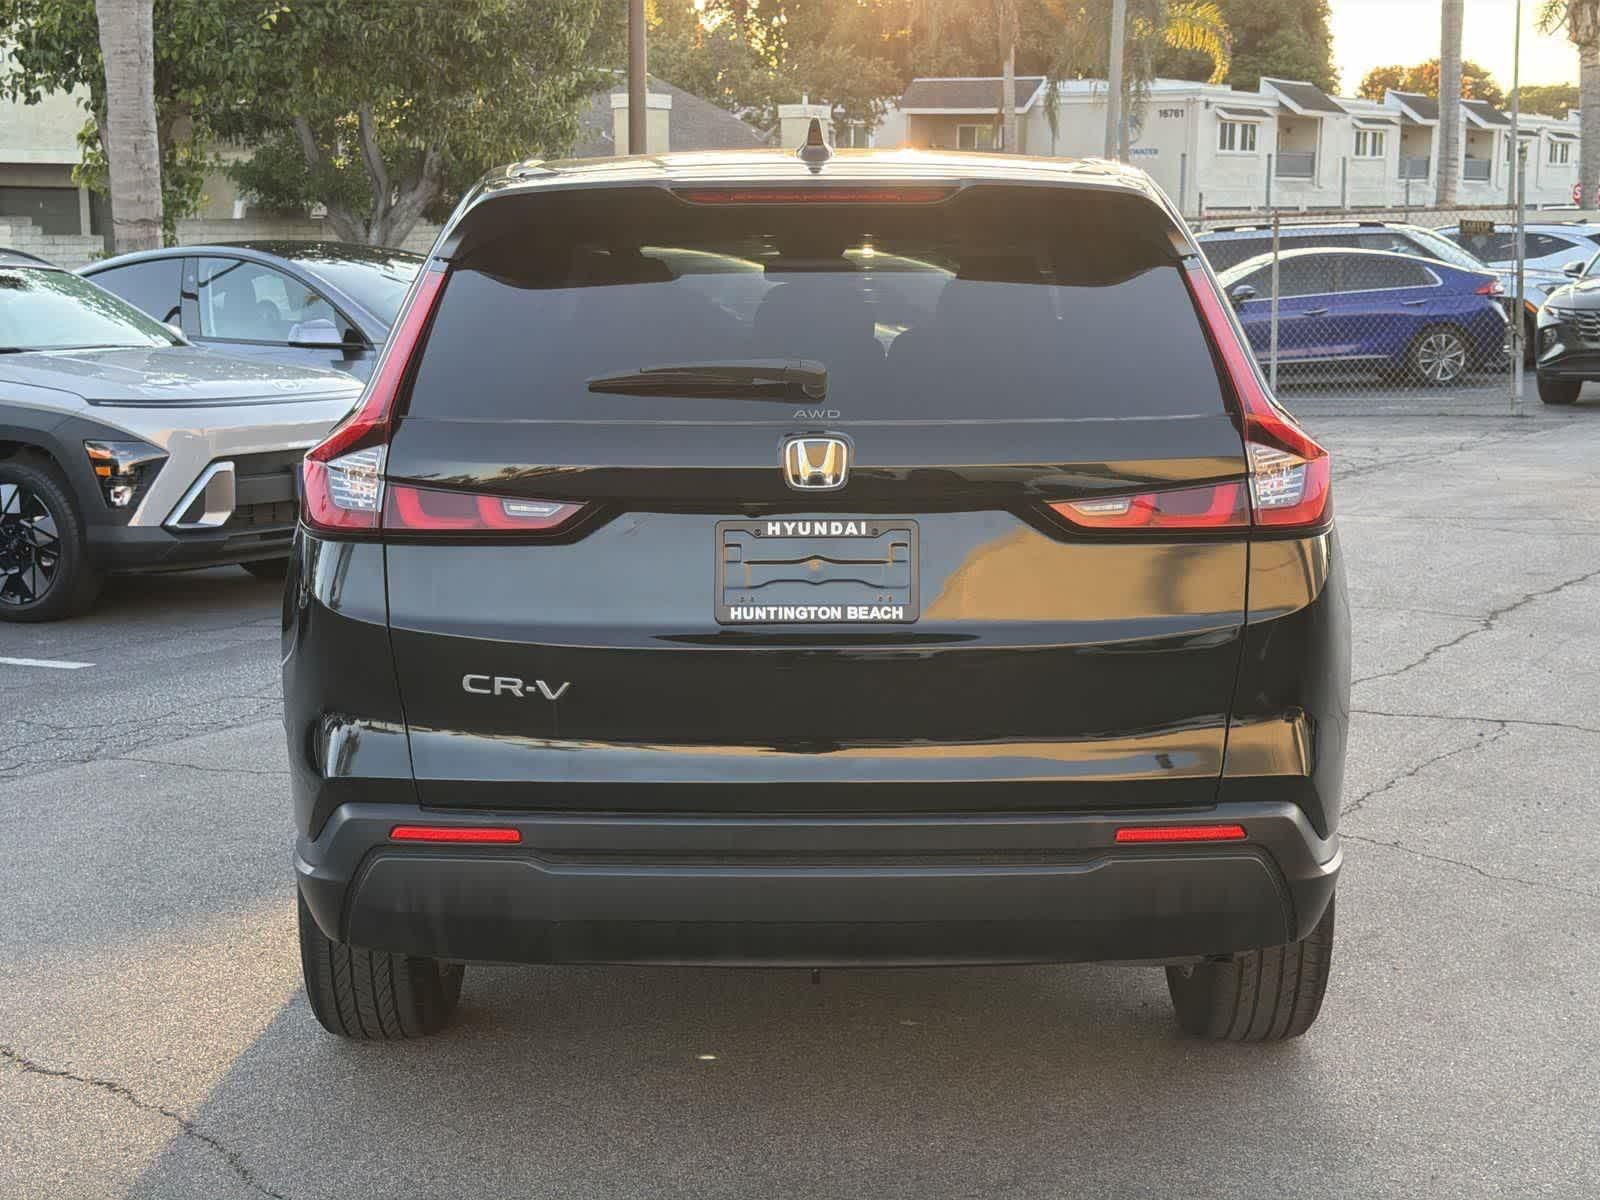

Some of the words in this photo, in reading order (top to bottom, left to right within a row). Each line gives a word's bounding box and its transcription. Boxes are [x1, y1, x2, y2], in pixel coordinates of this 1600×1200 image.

[793, 410, 841, 418] AWD
[767, 522, 866, 536] HYUNDAI
[730, 606, 843, 620] HUNTINGTON
[847, 606, 903, 620] BEACH
[462, 673, 571, 700] CR-V
